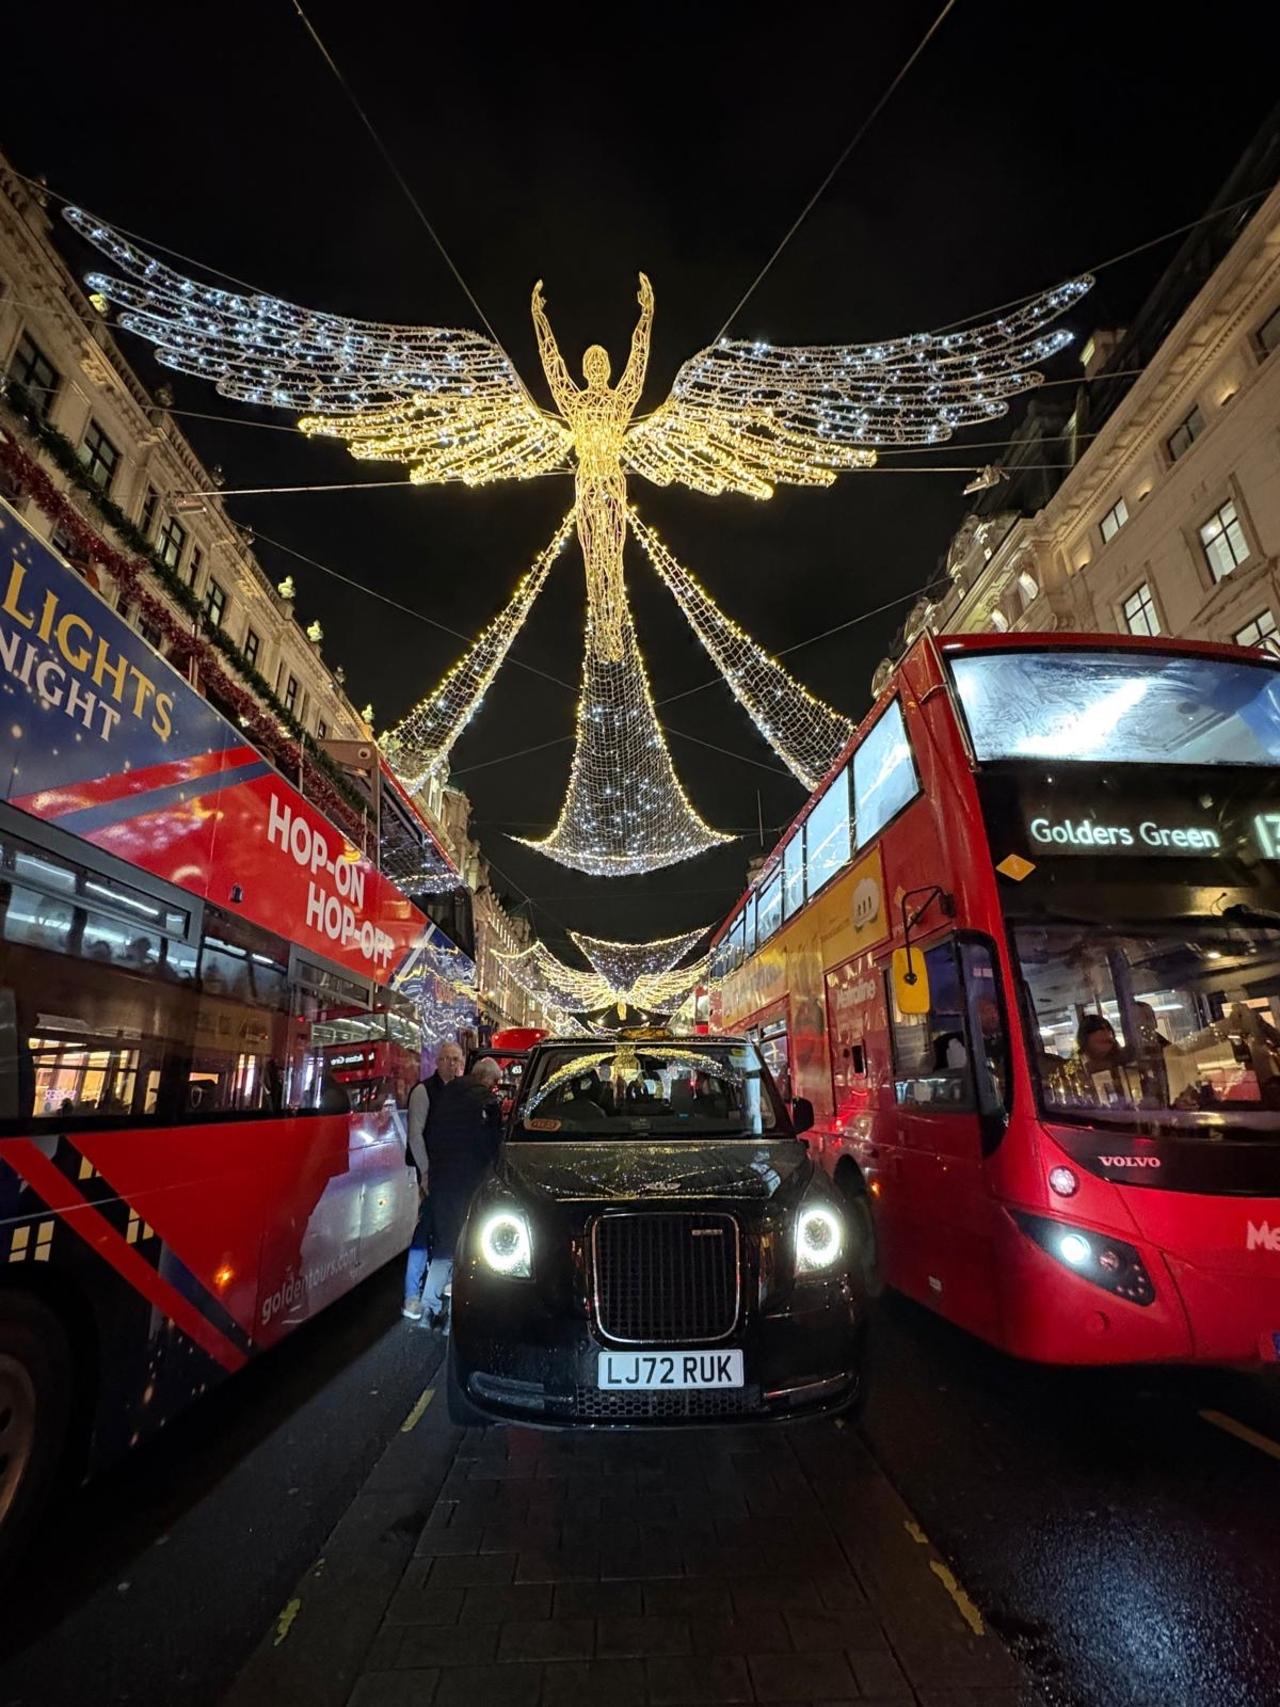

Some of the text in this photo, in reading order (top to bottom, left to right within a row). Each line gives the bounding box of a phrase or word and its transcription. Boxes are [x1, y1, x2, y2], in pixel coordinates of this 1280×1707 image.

[2, 560, 174, 742] LIGHTS
[268, 793, 365, 910] HOP-ON
[1031, 818, 1220, 847] Golders Green
[306, 881, 395, 968] HOP-OFF
[1098, 1156, 1161, 1168] VOLVO
[608, 1355, 732, 1384] LJ72 RUK
